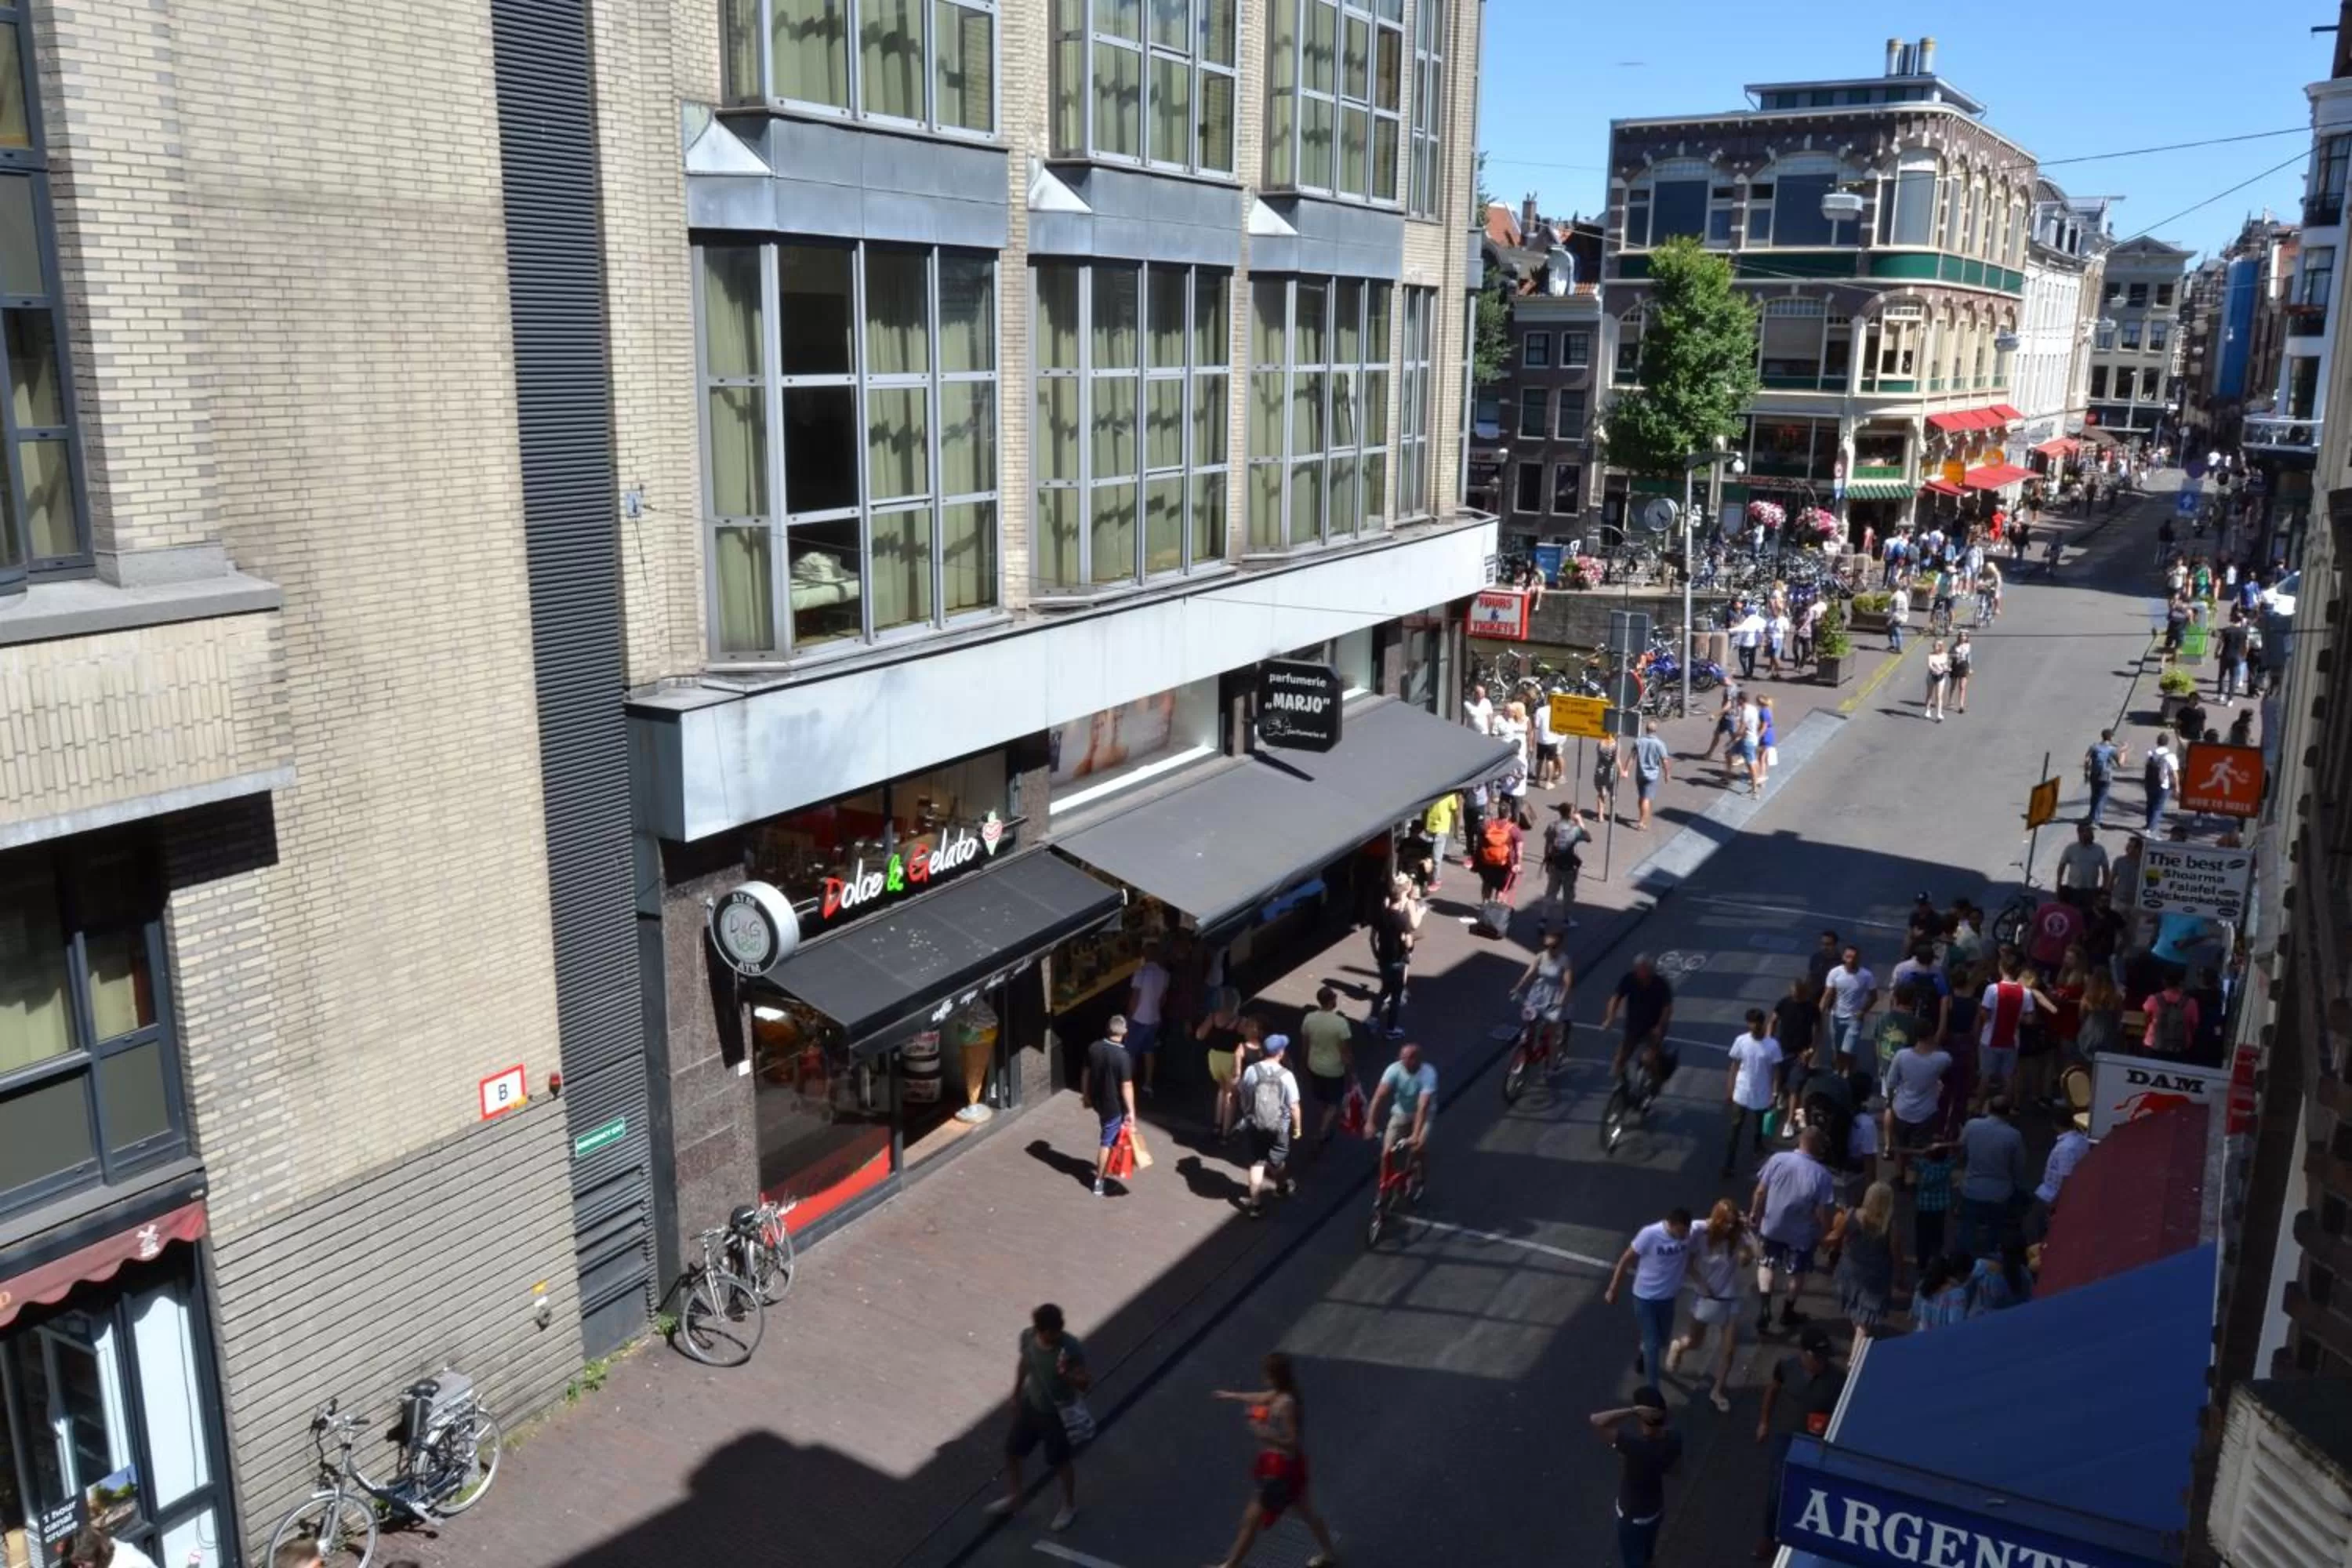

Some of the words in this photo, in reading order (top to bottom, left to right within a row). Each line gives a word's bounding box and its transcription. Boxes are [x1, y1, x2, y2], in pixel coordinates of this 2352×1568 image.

[1479, 596, 1513, 609] TOURS
[1490, 608, 1499, 621] &
[1269, 672, 1327, 688] parfumerie
[2149, 851, 2182, 868] The
[2186, 855, 2223, 872] best
[823, 858, 884, 919] Dolce
[887, 854, 904, 891] &
[908, 827, 979, 884] Gelato
[2164, 869, 2225, 884] Shoarma
[2169, 880, 2217, 895] Falafel
[732, 893, 756, 907] ATM
[2143, 888, 2241, 908] Chickenkebab
[739, 960, 762, 973] ATM
[2126, 1069, 2206, 1094] DAM
[51, 1501, 76, 1519] hour
[43, 1512, 74, 1534] canal
[1793, 1488, 2095, 1568] ARGENT
[45, 1521, 78, 1544] cruise
